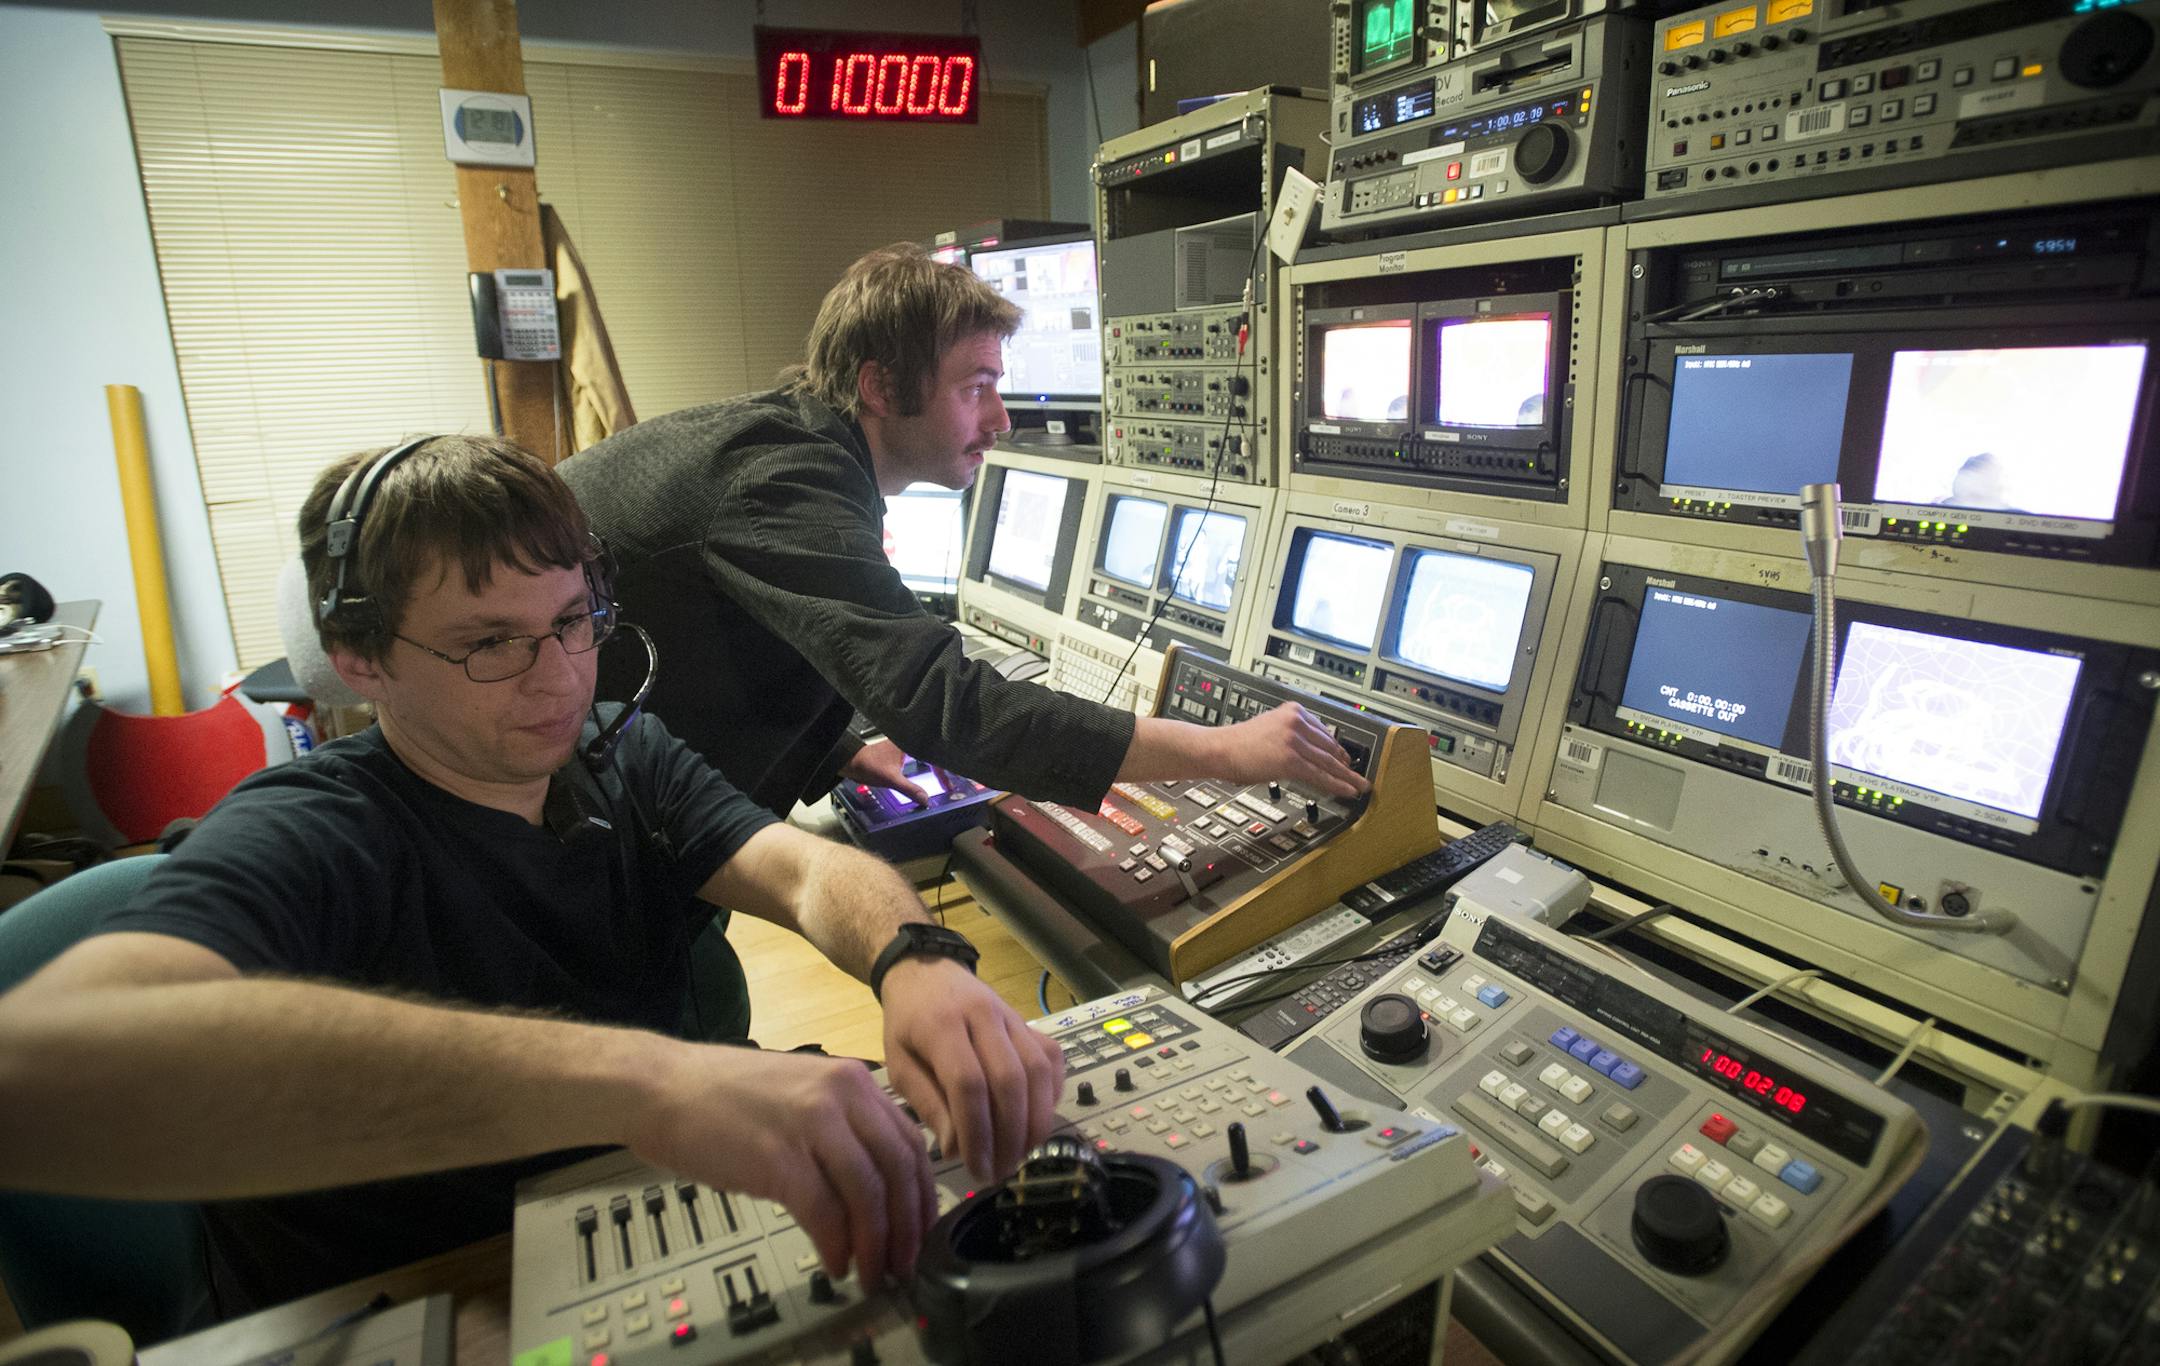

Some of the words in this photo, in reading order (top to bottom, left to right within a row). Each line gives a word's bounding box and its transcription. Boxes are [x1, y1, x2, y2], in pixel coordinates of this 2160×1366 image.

[1666, 80, 1711, 97] Panasonic
[1674, 344, 1706, 355] Marshall
[1465, 433, 1488, 442] SONY
[1727, 492, 1758, 502] TOASTER
[1758, 494, 1787, 504] PREVIEW
[1333, 502, 1361, 516] Camera
[1362, 504, 1370, 517] 3
[1659, 684, 1680, 698] CNT
[1667, 696, 1716, 718] CASSETTE
[1717, 709, 1738, 723] OUT
[1880, 779, 1921, 798] PLAYBACK
[1454, 905, 1485, 927] SONY
